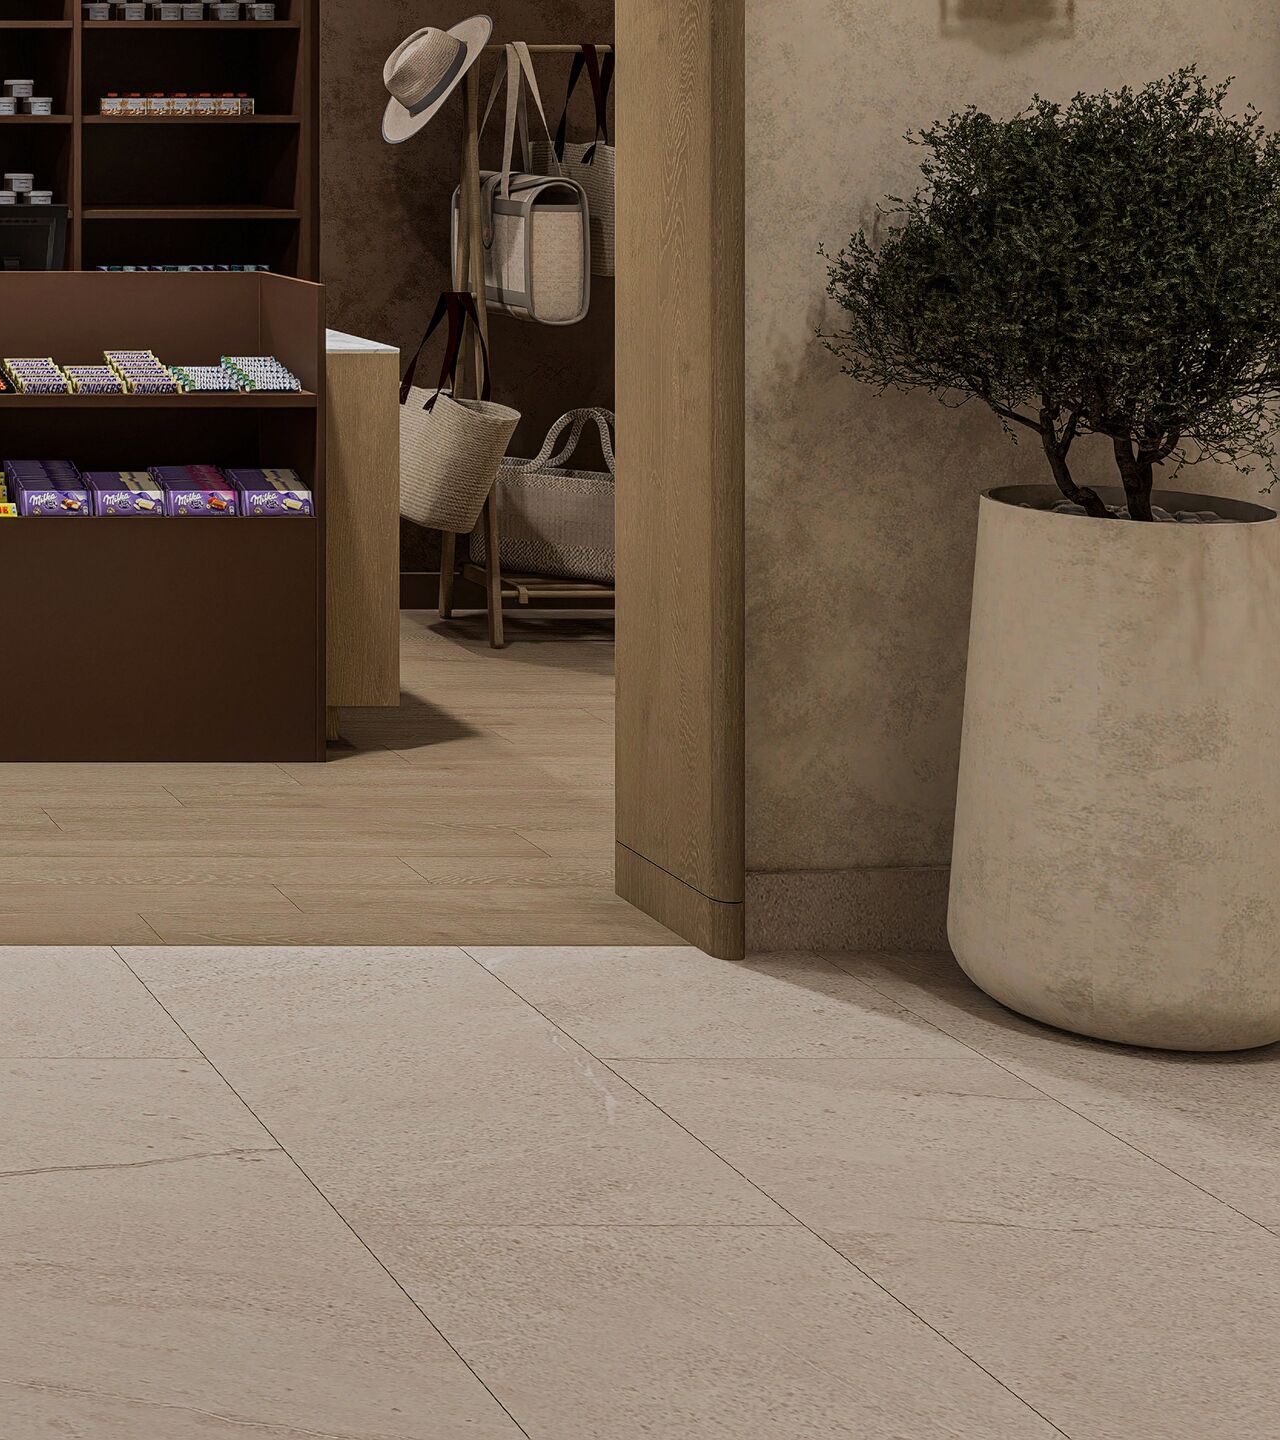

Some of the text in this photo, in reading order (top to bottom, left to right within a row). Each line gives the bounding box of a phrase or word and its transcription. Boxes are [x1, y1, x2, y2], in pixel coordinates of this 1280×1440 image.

[25, 383, 68, 394] SNICKERS
[79, 383, 121, 394] SNICKERS
[134, 383, 177, 394] SNICKERS
[29, 492, 58, 506] Milka
[102, 492, 132, 506] Milka
[174, 492, 203, 506] Milka
[250, 492, 278, 506] Milka
